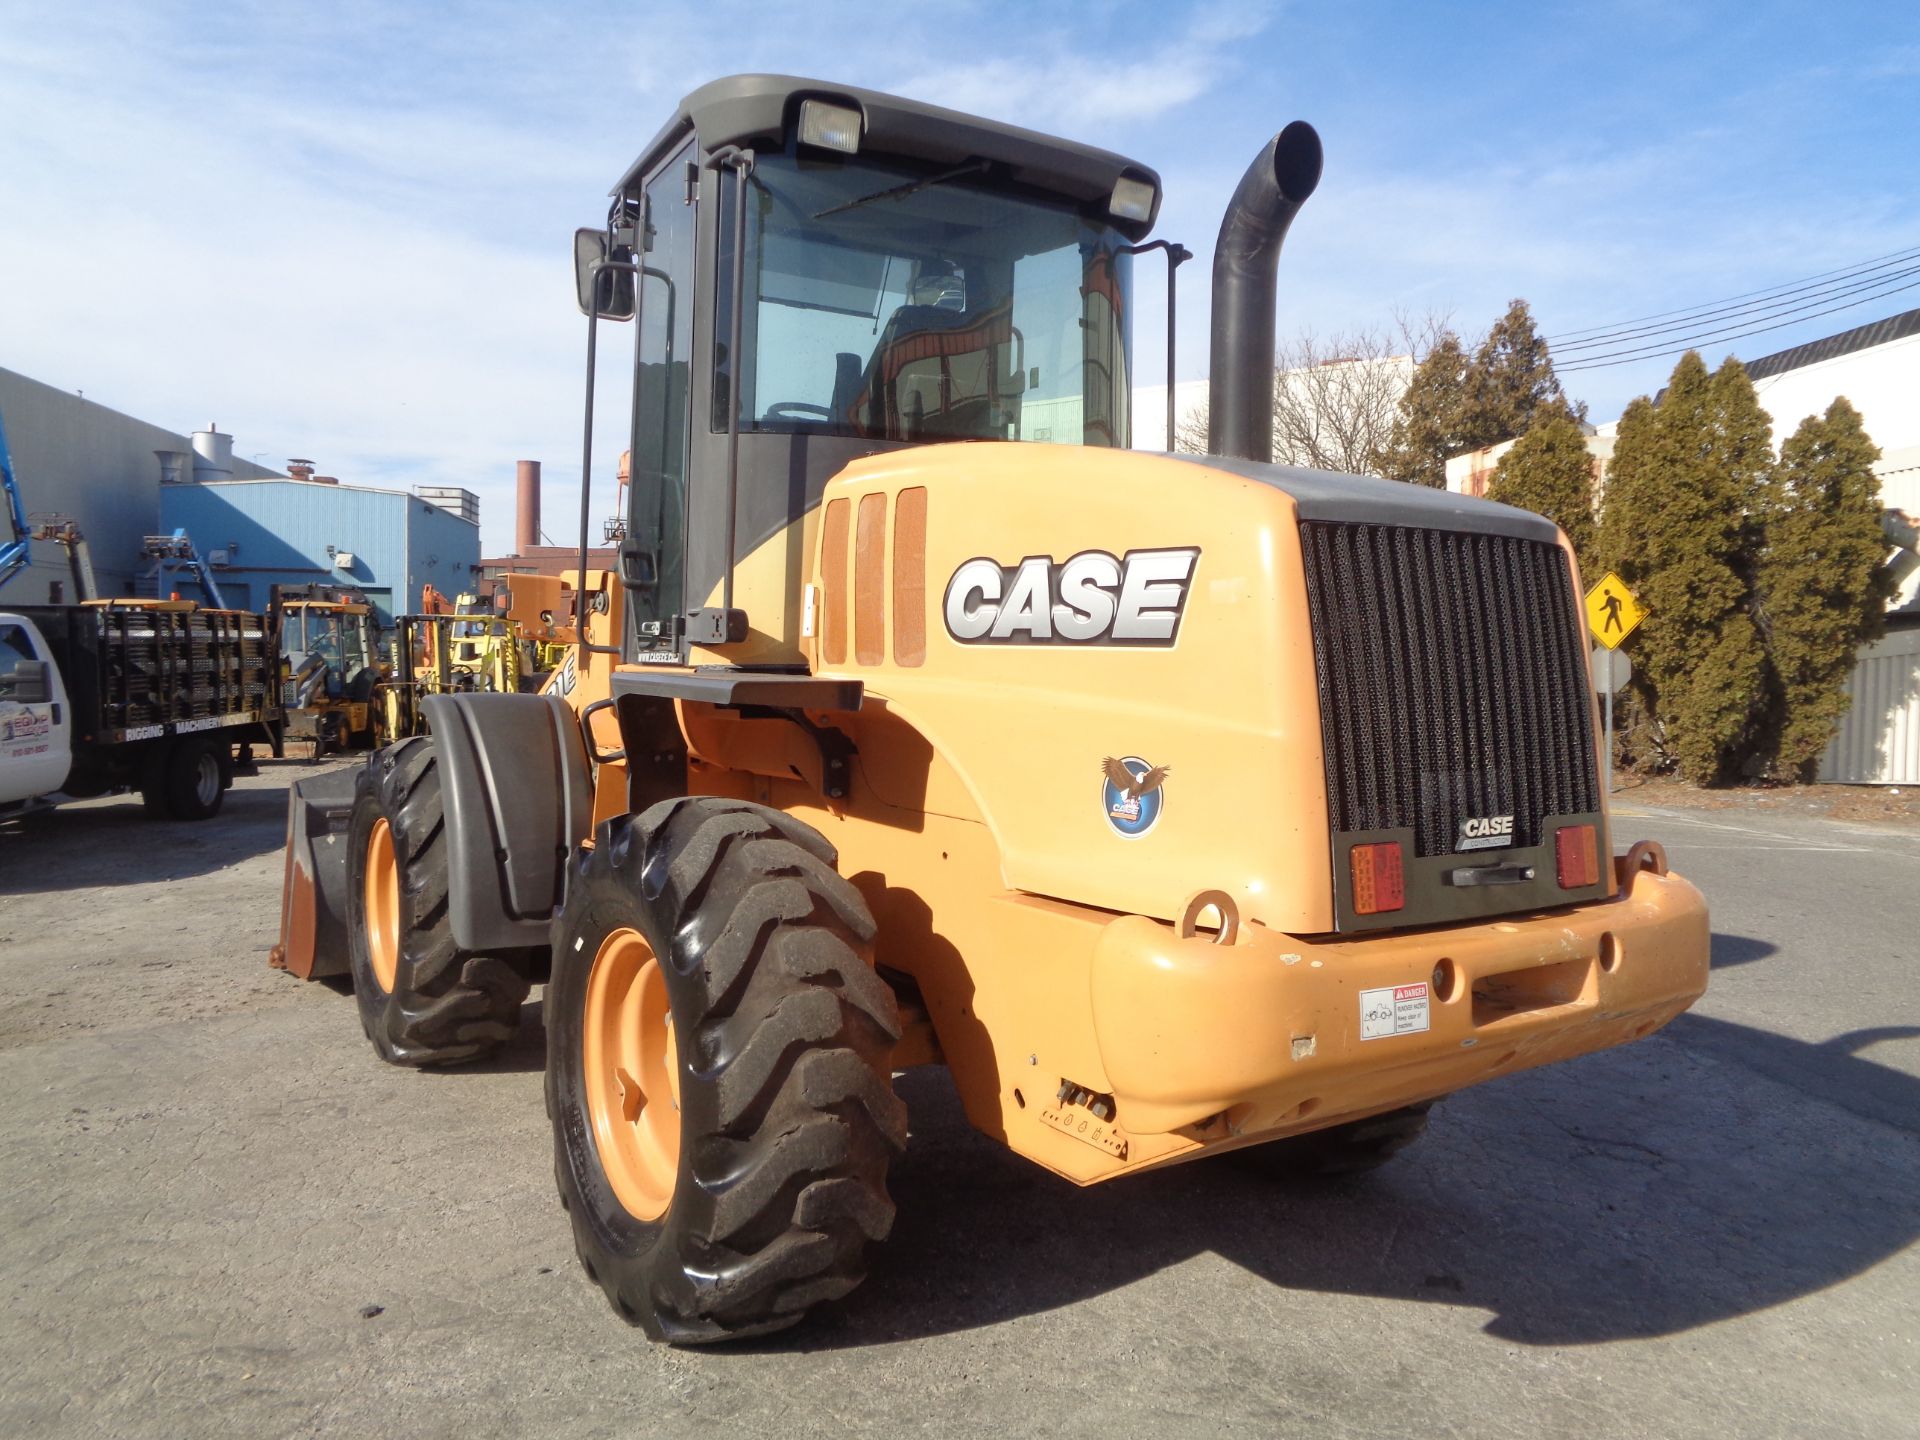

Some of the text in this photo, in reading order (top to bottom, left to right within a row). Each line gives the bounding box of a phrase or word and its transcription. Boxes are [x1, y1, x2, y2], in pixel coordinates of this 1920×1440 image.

[943, 546, 1201, 648] CASE
[125, 724, 164, 742] RIGGING
[176, 715, 221, 734] MACHINERY
[1112, 803, 1140, 815] CASE
[1465, 815, 1514, 837] CASE
[1405, 987, 1425, 998] DANGER
